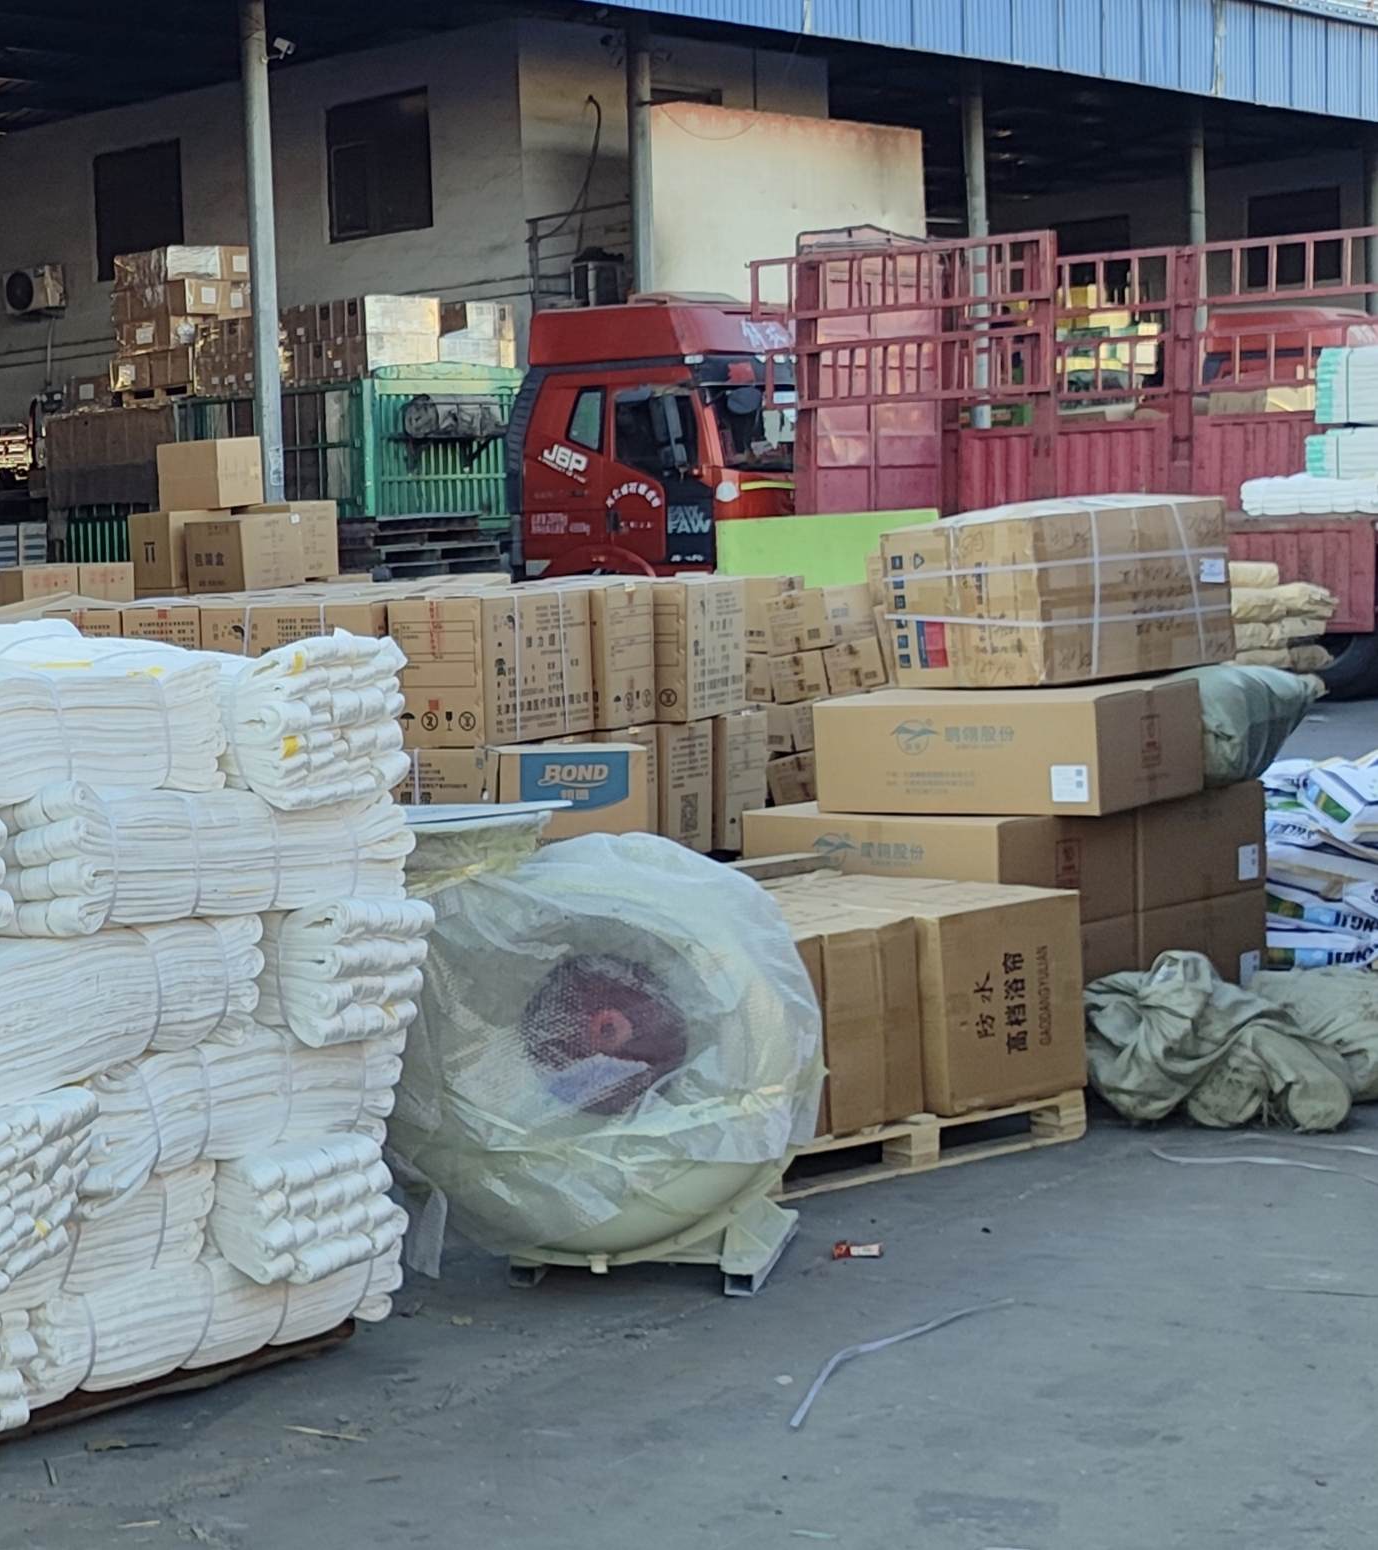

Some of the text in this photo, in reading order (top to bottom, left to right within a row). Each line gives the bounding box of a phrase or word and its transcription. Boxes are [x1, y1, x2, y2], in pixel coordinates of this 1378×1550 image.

[667, 517, 712, 534] FAW
[541, 764, 609, 783] BOND
[1002, 951, 1029, 1055] 高档浴帘
